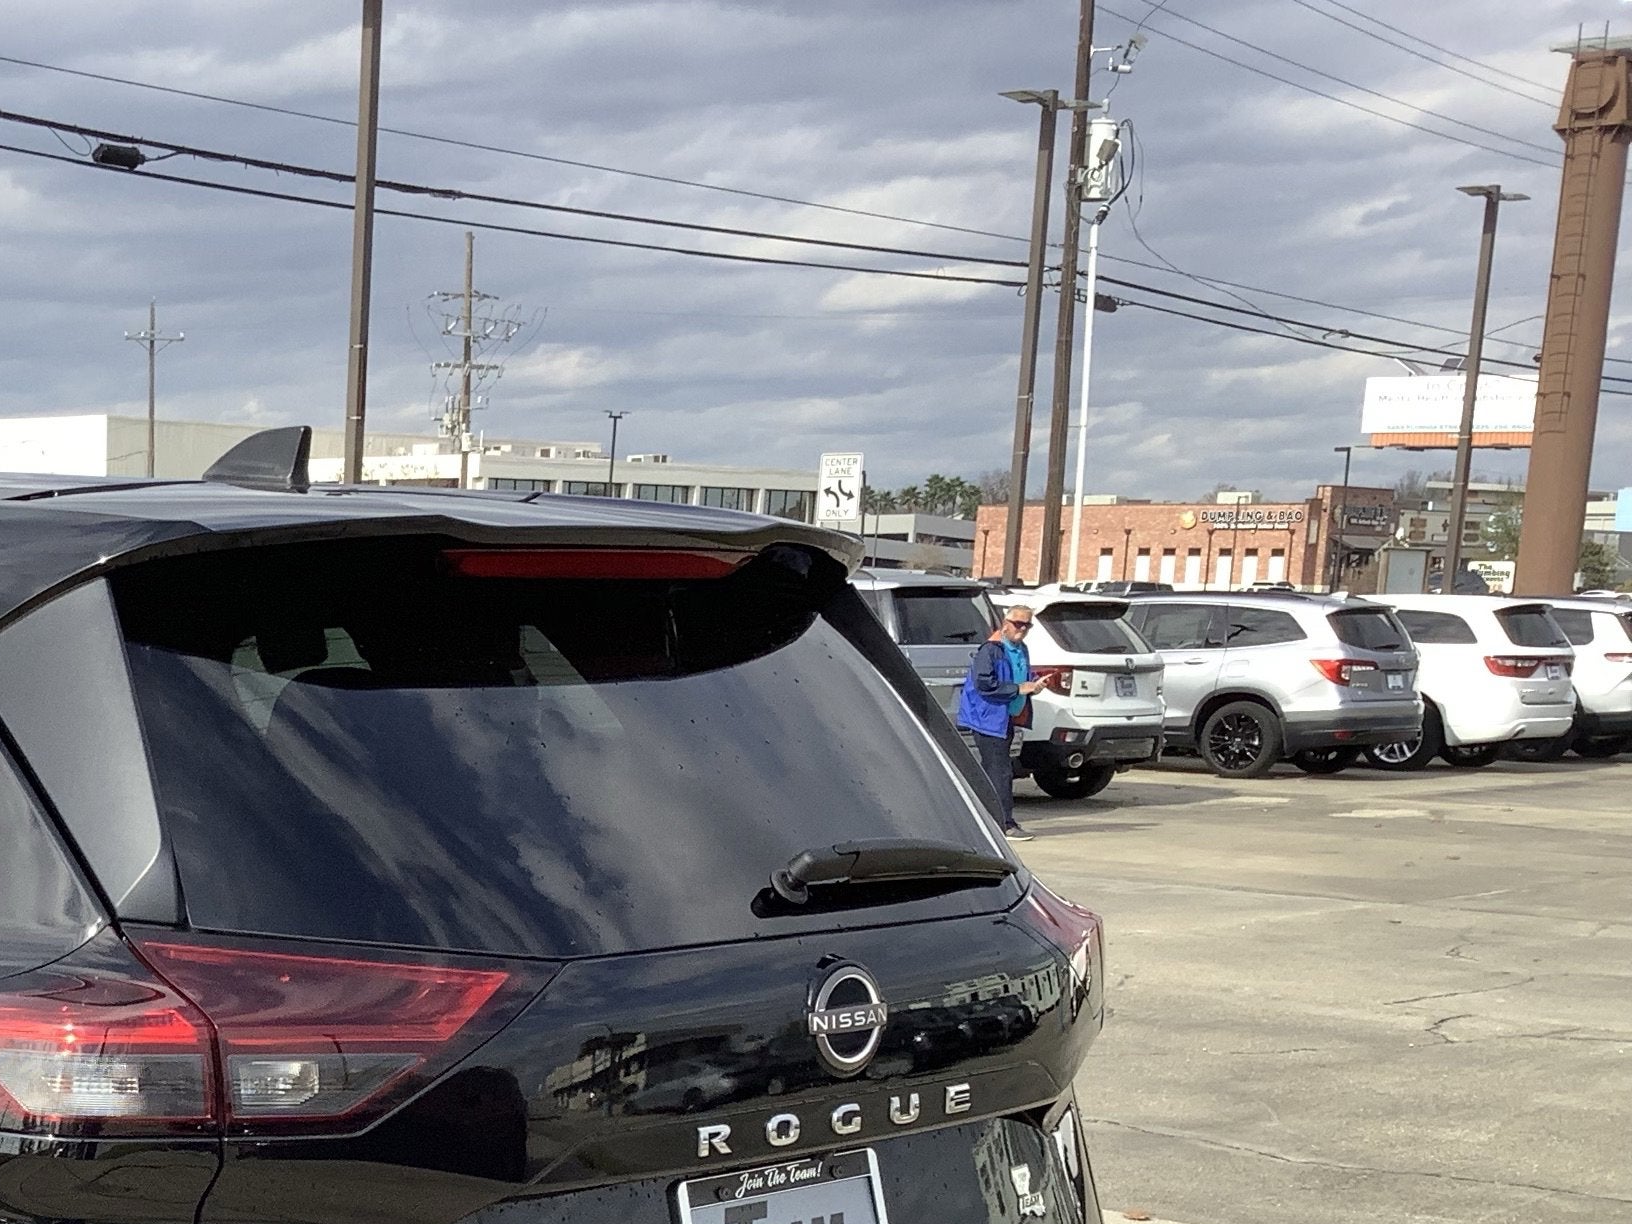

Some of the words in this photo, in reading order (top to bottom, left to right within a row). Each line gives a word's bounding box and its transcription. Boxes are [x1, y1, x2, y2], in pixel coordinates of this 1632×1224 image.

[825, 457, 858, 467] CENTER
[829, 467, 853, 476] LANE
[825, 508, 849, 518] ONLY
[1277, 511, 1304, 522] BAO
[812, 1006, 888, 1032] NISSAN
[696, 1082, 972, 1158] ROGUE
[734, 1172, 764, 1199] Join
[764, 1167, 788, 1188] The
[786, 1161, 823, 1184] Team!
